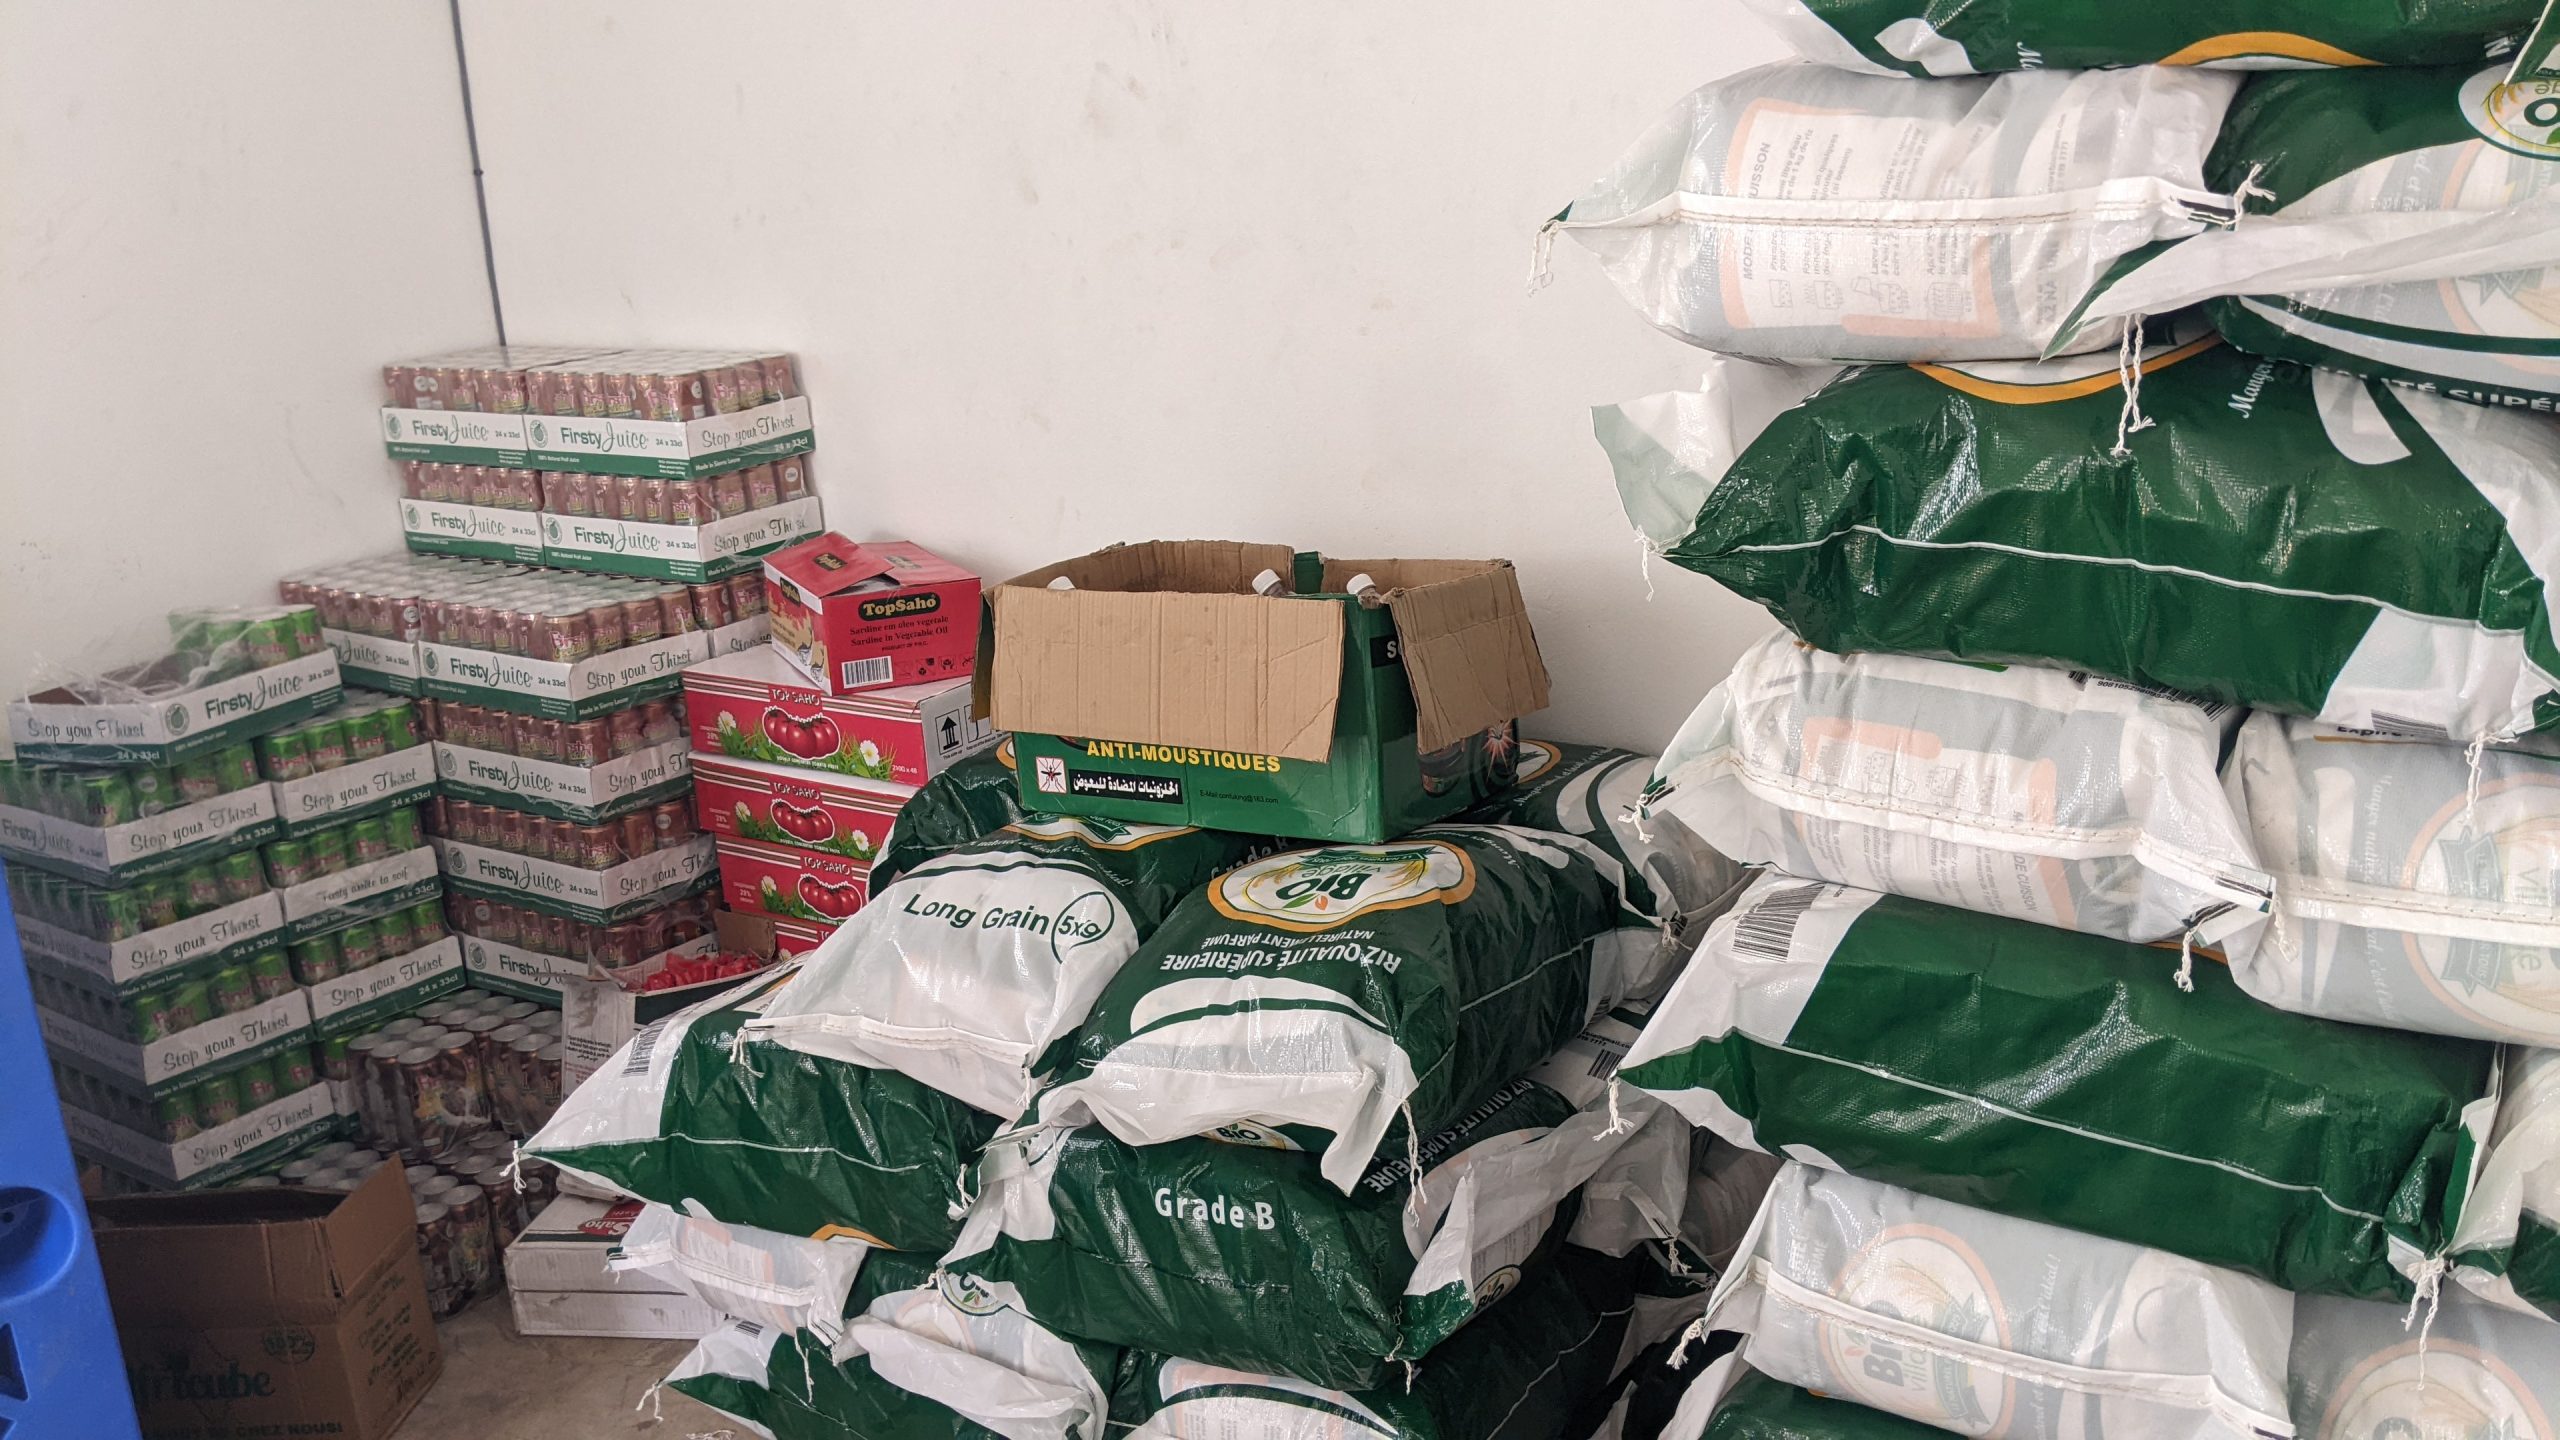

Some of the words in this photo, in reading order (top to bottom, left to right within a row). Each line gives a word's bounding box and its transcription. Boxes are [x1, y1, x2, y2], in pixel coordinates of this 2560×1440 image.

[412, 420, 449, 442] Firsty
[449, 414, 488, 444] Juice
[560, 427, 602, 447] Firsty
[602, 421, 648, 452] Juice
[702, 429, 731, 449] Stop
[735, 428, 757, 446] your
[756, 414, 795, 436] Thirst
[431, 512, 466, 534] Firsty
[465, 509, 505, 537] Juice
[574, 526, 614, 547] Firsty
[614, 522, 660, 552] Juice
[714, 534, 739, 552] Stop
[743, 529, 766, 548] your
[863, 597, 937, 617] TopSaho
[850, 621, 883, 635] Sardine
[851, 633, 883, 646] Sardine
[884, 634, 893, 642] in
[450, 658, 488, 684] Firsty
[488, 656, 533, 688] Juice
[587, 671, 616, 690] Stop
[620, 665, 647, 686] your
[650, 648, 692, 672] Thirst
[205, 692, 252, 719] Firsty
[252, 675, 302, 711] Juice
[66, 723, 92, 743] your
[1087, 740, 1281, 773] ANTI-MOUSTIQUES
[468, 760, 508, 787] Firsty
[507, 760, 553, 793] Juice
[641, 764, 666, 788] your
[303, 793, 335, 813] Stop
[340, 786, 369, 807] your
[131, 833, 167, 853] Stop
[172, 823, 204, 844] your
[478, 859, 519, 885] Firsty
[518, 861, 563, 893] Juice
[903, 893, 977, 929] Long
[981, 905, 1050, 936] Grain
[131, 950, 168, 970] Stop
[174, 937, 207, 960] your
[210, 914, 261, 943] Thirst
[1201, 933, 1262, 950] PARFUMÉ
[500, 954, 539, 984] Firsty
[1160, 947, 1277, 974] SUPÉRIEURE
[1277, 943, 1361, 971] QUALITÉ
[1364, 945, 1402, 975] RIZ
[369, 976, 396, 996] your
[400, 954, 443, 982] Thirst
[164, 1048, 199, 1072] Stop
[204, 1036, 236, 1061] your
[240, 1014, 289, 1042] Thirst
[233, 1129, 263, 1151] your
[1154, 1188, 1244, 1228] Grade
[1257, 1202, 1275, 1230] B
